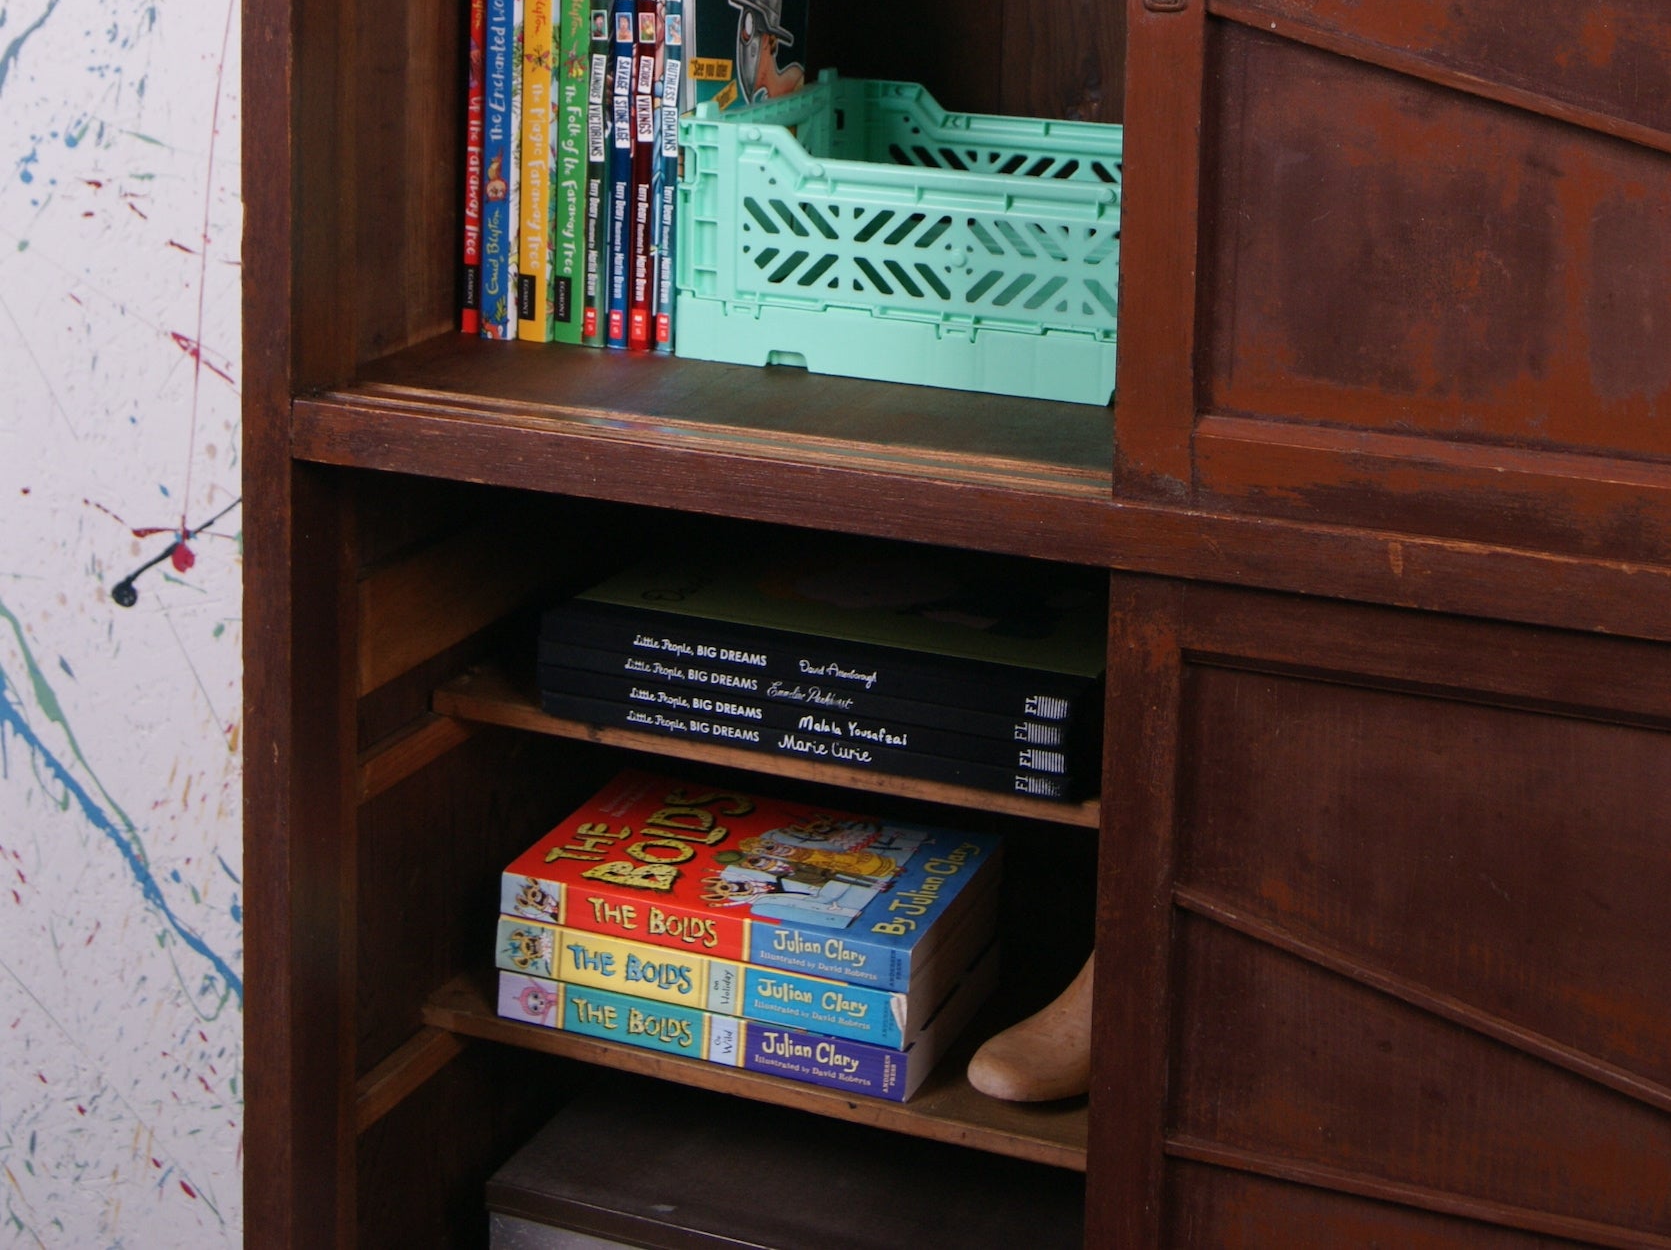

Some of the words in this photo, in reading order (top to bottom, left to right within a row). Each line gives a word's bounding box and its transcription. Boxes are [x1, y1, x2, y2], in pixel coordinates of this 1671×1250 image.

[489, 26, 507, 112] Enchanted
[591, 57, 605, 99] VILLAINOUS
[617, 60, 630, 90] SAVAGE
[640, 59, 652, 87] VICIOUS
[665, 62, 679, 101] RUTHLESS
[491, 113, 504, 142] The
[616, 100, 628, 124] STONE
[638, 98, 651, 134] VIKINGS
[590, 107, 603, 157] VICTORIANS
[616, 127, 629, 141] AGE
[664, 110, 676, 151] ROMANS
[466, 146, 481, 219] Faraway
[527, 159, 545, 230] Faraway
[560, 179, 578, 238] Faraway
[465, 224, 480, 256] Tree
[527, 234, 545, 269] Tree
[560, 239, 577, 275] Tree
[633, 635, 659, 649] Little
[660, 638, 694, 656] People,
[697, 644, 717, 659] BIG
[719, 648, 767, 666] DREAMS
[799, 659, 826, 677] David
[624, 658, 651, 673] Little
[652, 661, 686, 680] People,
[688, 668, 708, 683] BIG
[710, 671, 758, 691] DREAMS
[630, 687, 655, 702] Little
[656, 691, 690, 710] People,
[692, 697, 713, 712] BIG
[715, 700, 763, 720] DREAMS
[626, 710, 653, 725] Little
[652, 714, 687, 732] People,
[690, 720, 710, 735] BIG
[712, 724, 760, 743] DREAMS
[798, 715, 843, 737] Malala
[848, 721, 908, 746] Yousafzai
[778, 734, 829, 755] Marie
[832, 741, 872, 763] Curie
[545, 822, 631, 864] THE
[580, 788, 756, 892] BOLDS
[924, 842, 982, 876] Clary
[889, 880, 945, 917] Julian
[587, 897, 637, 931] THE
[649, 906, 718, 949] BOLDS
[871, 916, 917, 936] By
[760, 950, 805, 967] Illustrated
[806, 961, 816, 970] by
[818, 962, 842, 975] David
[844, 967, 878, 981] Roberts
[773, 929, 821, 955] Julian
[824, 939, 867, 967] Clary
[567, 943, 616, 977] THE
[625, 952, 694, 994] BOLDS
[721, 969, 735, 1005] Holiday
[757, 978, 812, 1004] Julian
[821, 991, 868, 1017] Clary
[571, 997, 618, 1030] THE
[627, 1006, 694, 1048] BOLDS
[754, 999, 800, 1016] Illustrated
[811, 1011, 836, 1024] David
[838, 1016, 871, 1030] Roberts
[722, 1030, 733, 1054] Wild
[761, 1032, 812, 1058] Julian
[816, 1042, 859, 1073] Clary
[754, 1054, 800, 1071] Illustrated
[801, 1065, 810, 1075] by
[811, 1066, 836, 1079] David
[838, 1071, 871, 1086] Roberts
[882, 1054, 891, 1093] ANDERSEN
